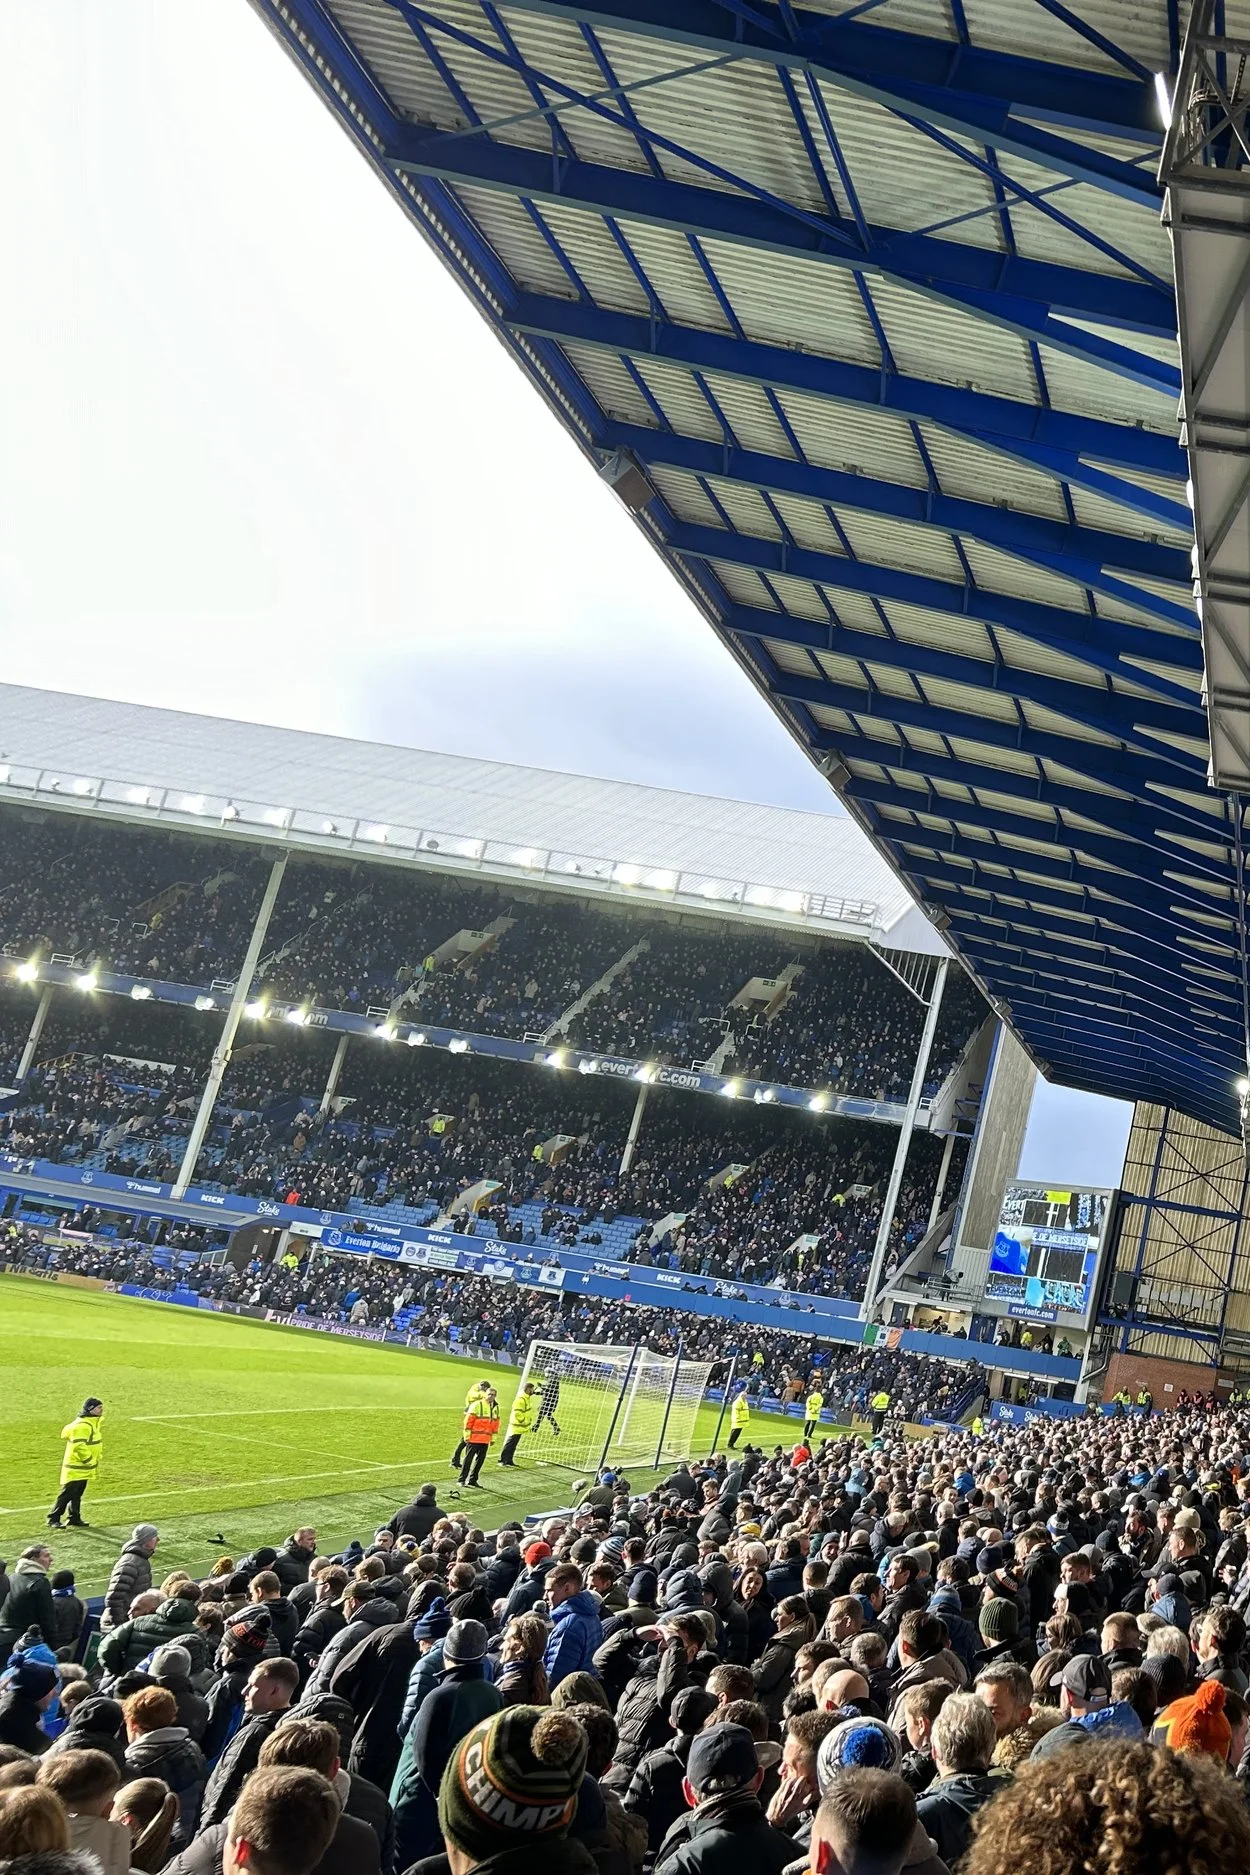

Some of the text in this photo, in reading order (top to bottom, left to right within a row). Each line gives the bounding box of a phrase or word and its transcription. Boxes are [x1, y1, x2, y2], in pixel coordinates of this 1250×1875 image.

[201, 1194, 225, 1205] KICK
[257, 1201, 280, 1216] Stake
[344, 1235, 371, 1249] Everton
[427, 1233, 452, 1245] KICK
[484, 1240, 507, 1256] Stake
[656, 1273, 682, 1285] KICK
[1011, 1305, 1054, 1319] evertonfc.com
[998, 1405, 1014, 1419] Stake
